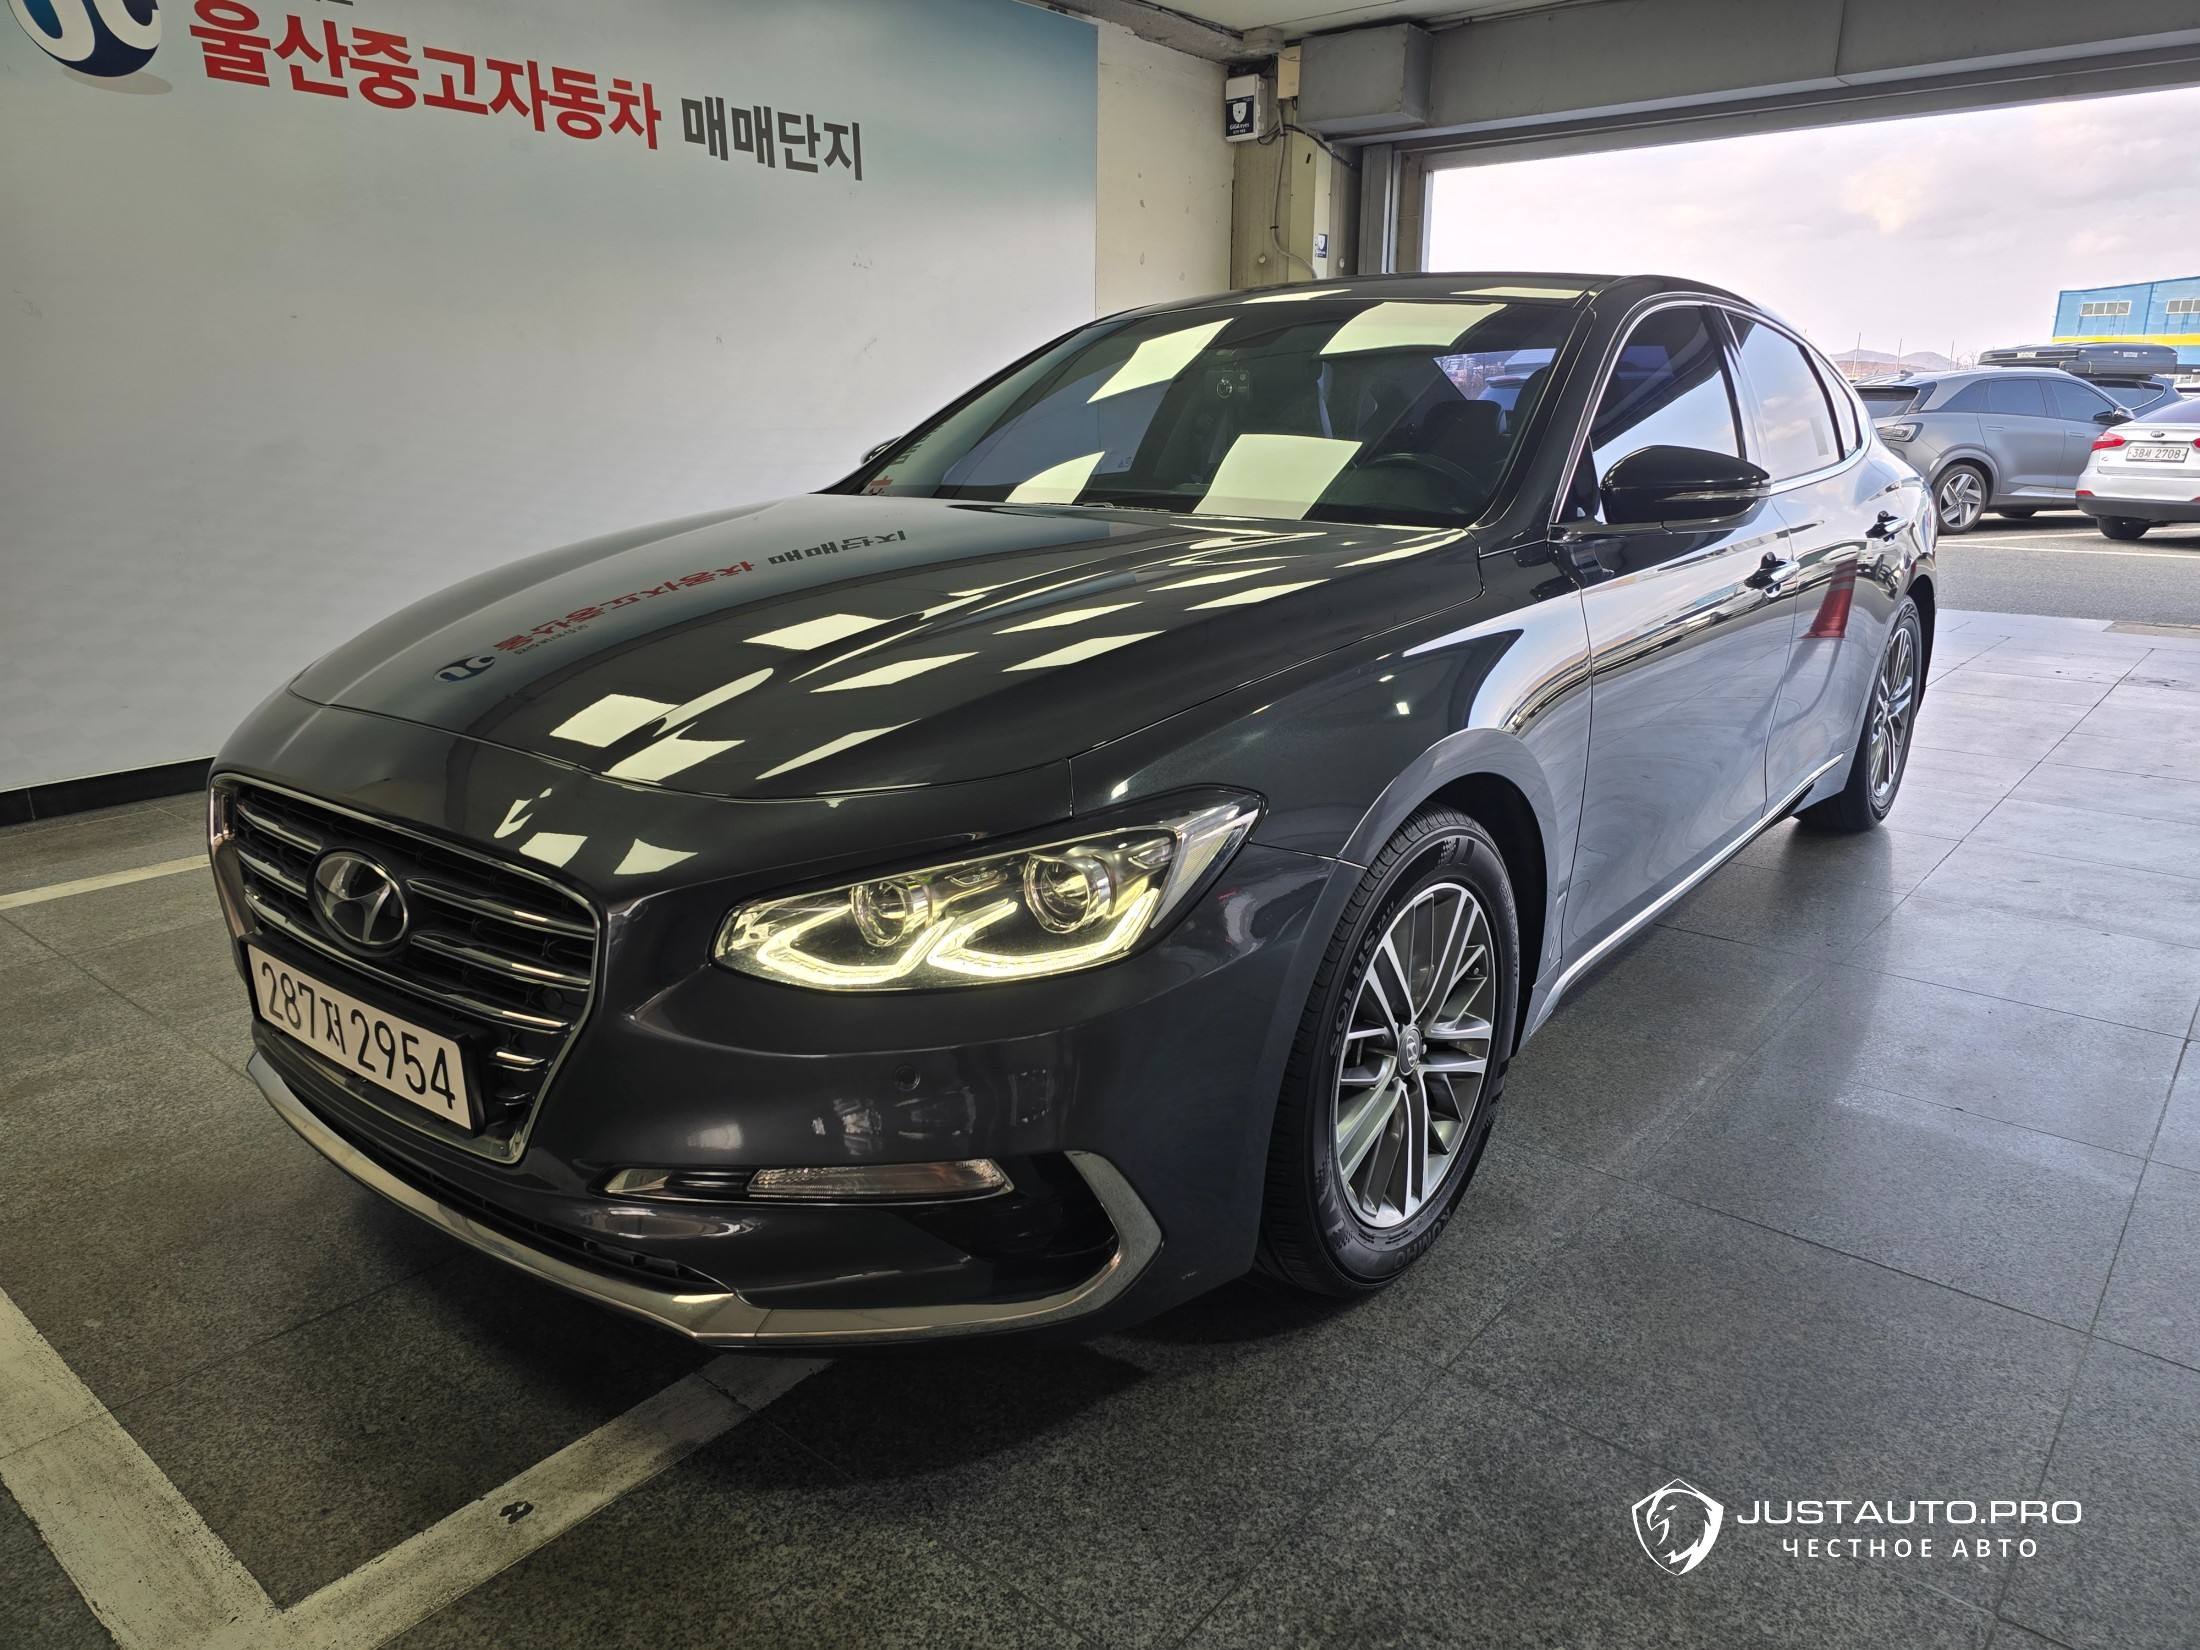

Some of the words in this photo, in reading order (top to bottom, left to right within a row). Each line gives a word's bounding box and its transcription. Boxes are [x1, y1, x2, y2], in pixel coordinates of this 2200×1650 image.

[189, 0, 662, 150] 울산중고자동차
[681, 96, 862, 181] 매매단지
[2154, 448, 2182, 459] 2708
[261, 961, 456, 1110] 287저2954
[1329, 929, 1377, 1057] SOLUS
[1393, 1202, 1452, 1271] KUMHO
